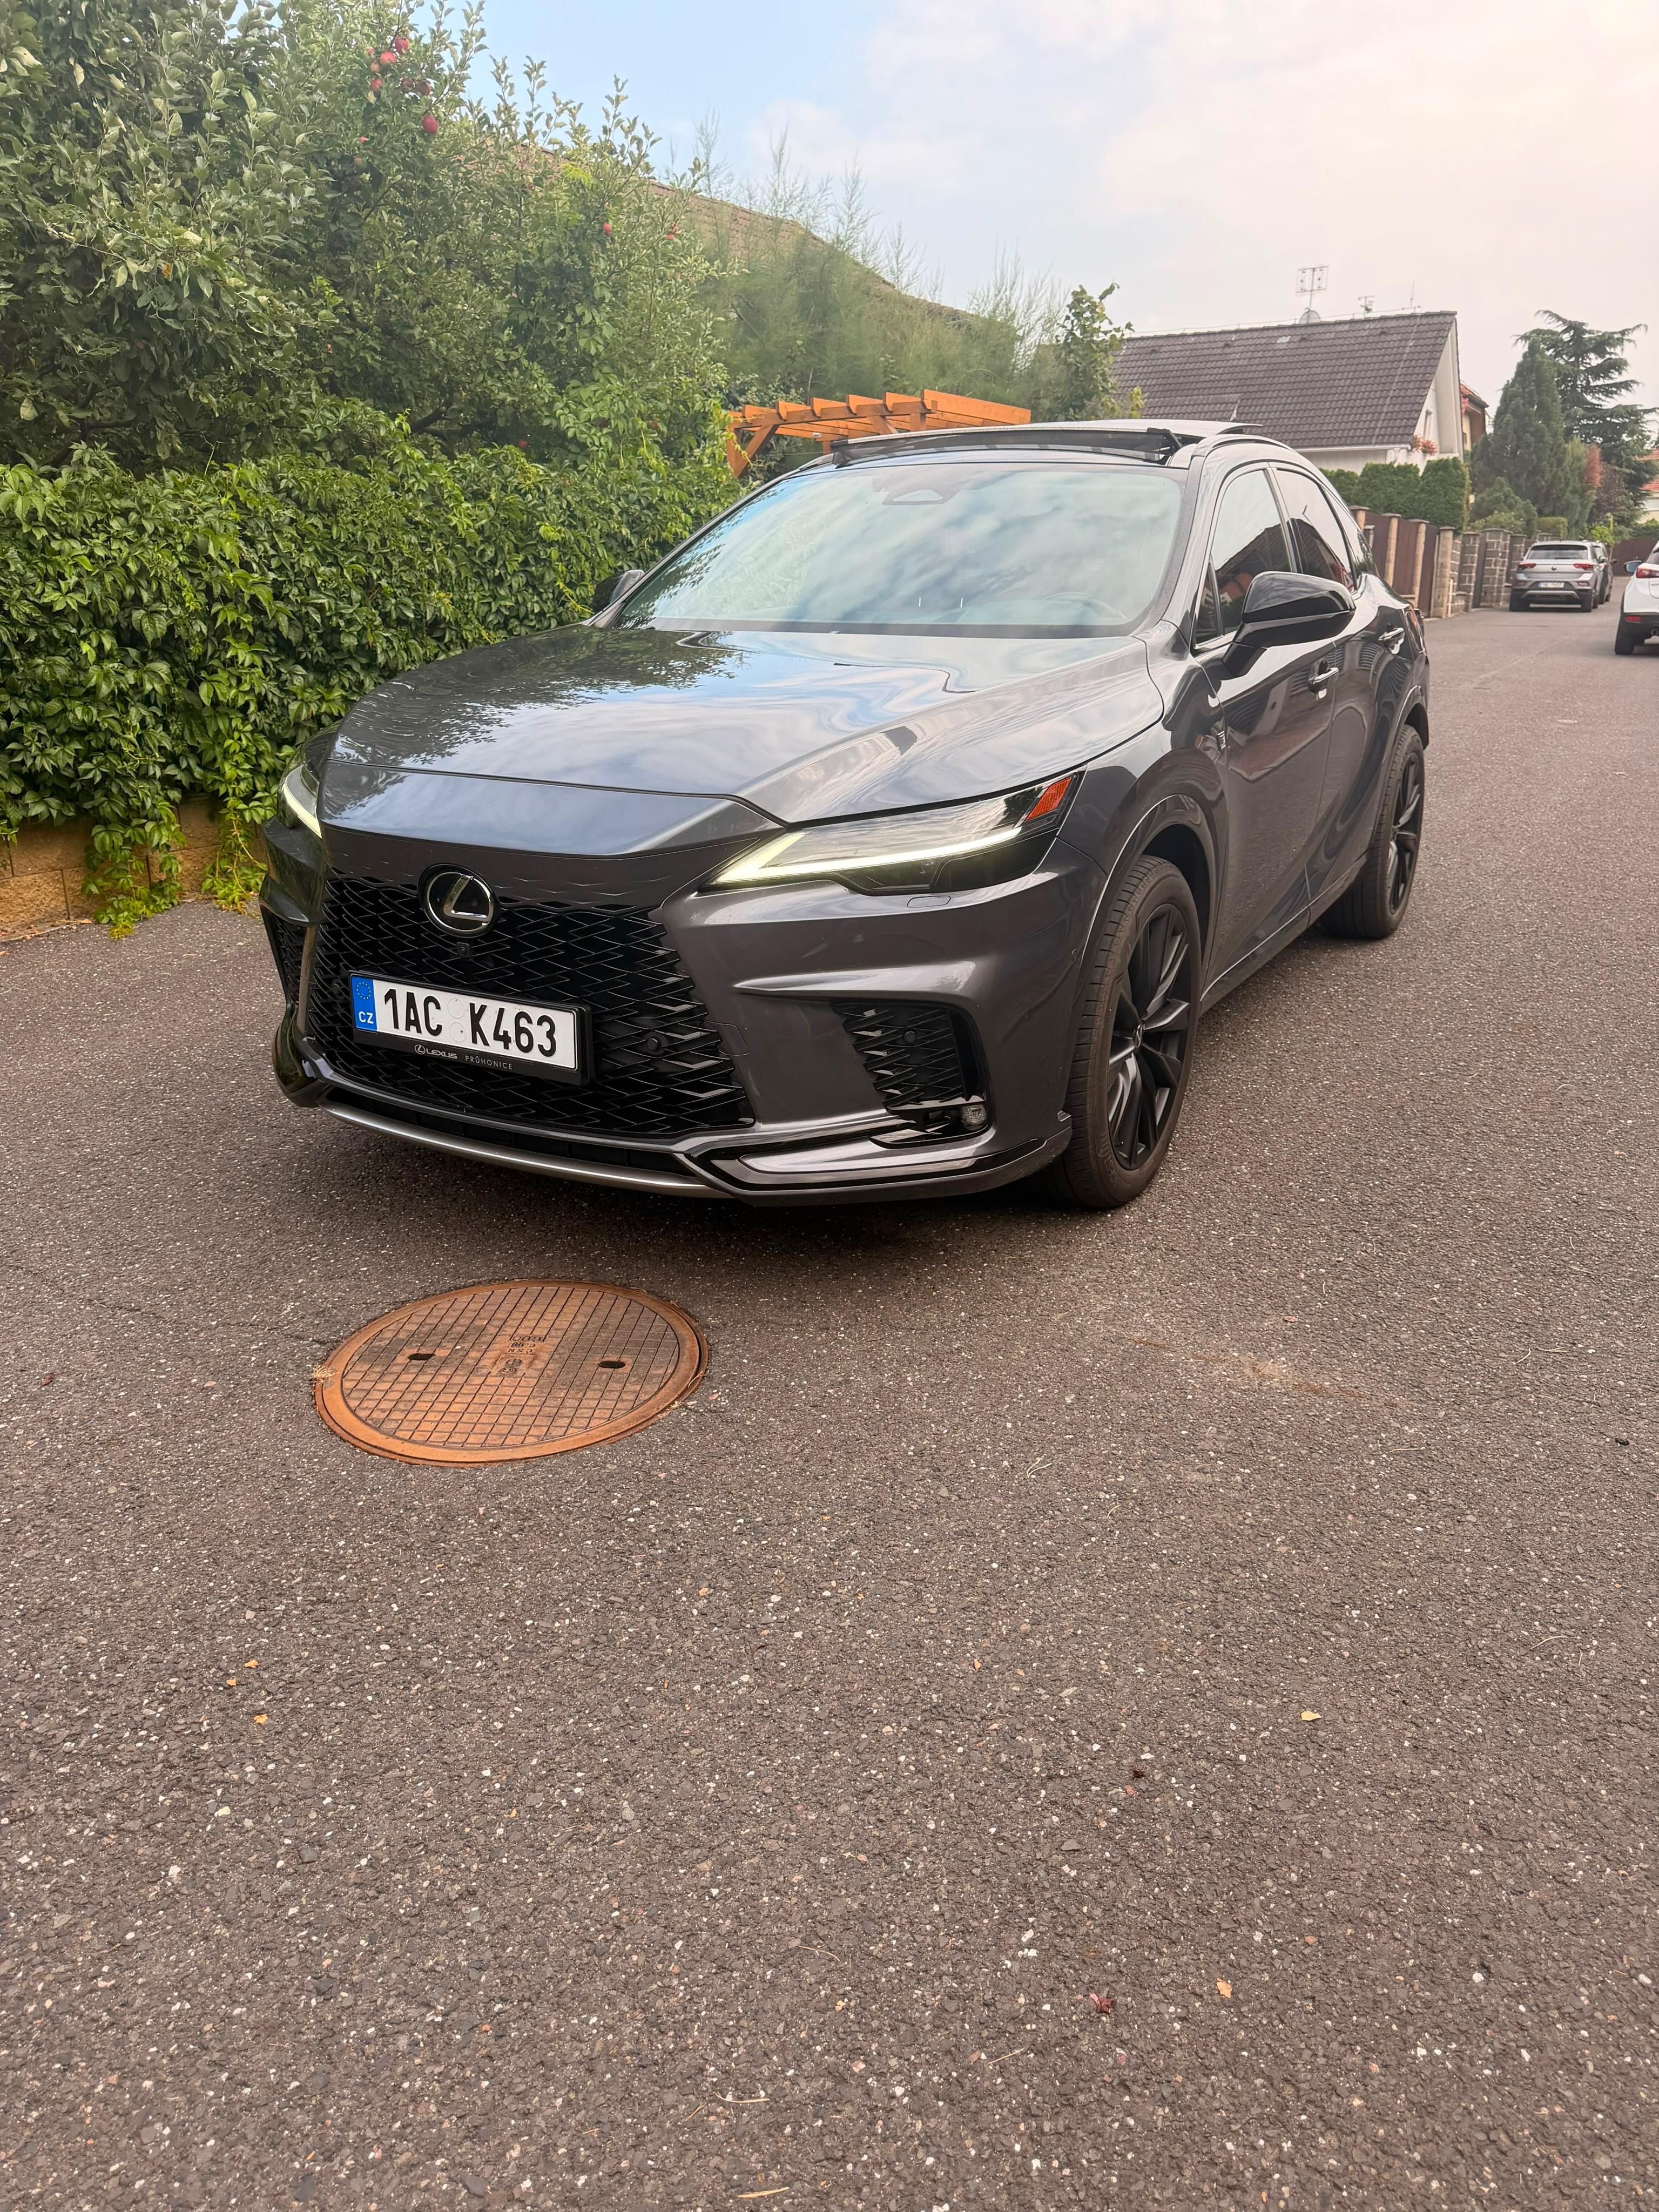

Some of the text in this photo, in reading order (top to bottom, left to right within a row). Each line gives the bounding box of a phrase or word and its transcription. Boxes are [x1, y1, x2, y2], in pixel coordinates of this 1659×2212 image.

[358, 1011, 374, 1024] CZ
[384, 988, 557, 1057] 1AC K463
[426, 1048, 513, 1070] LEXUS PRŮHONICE
